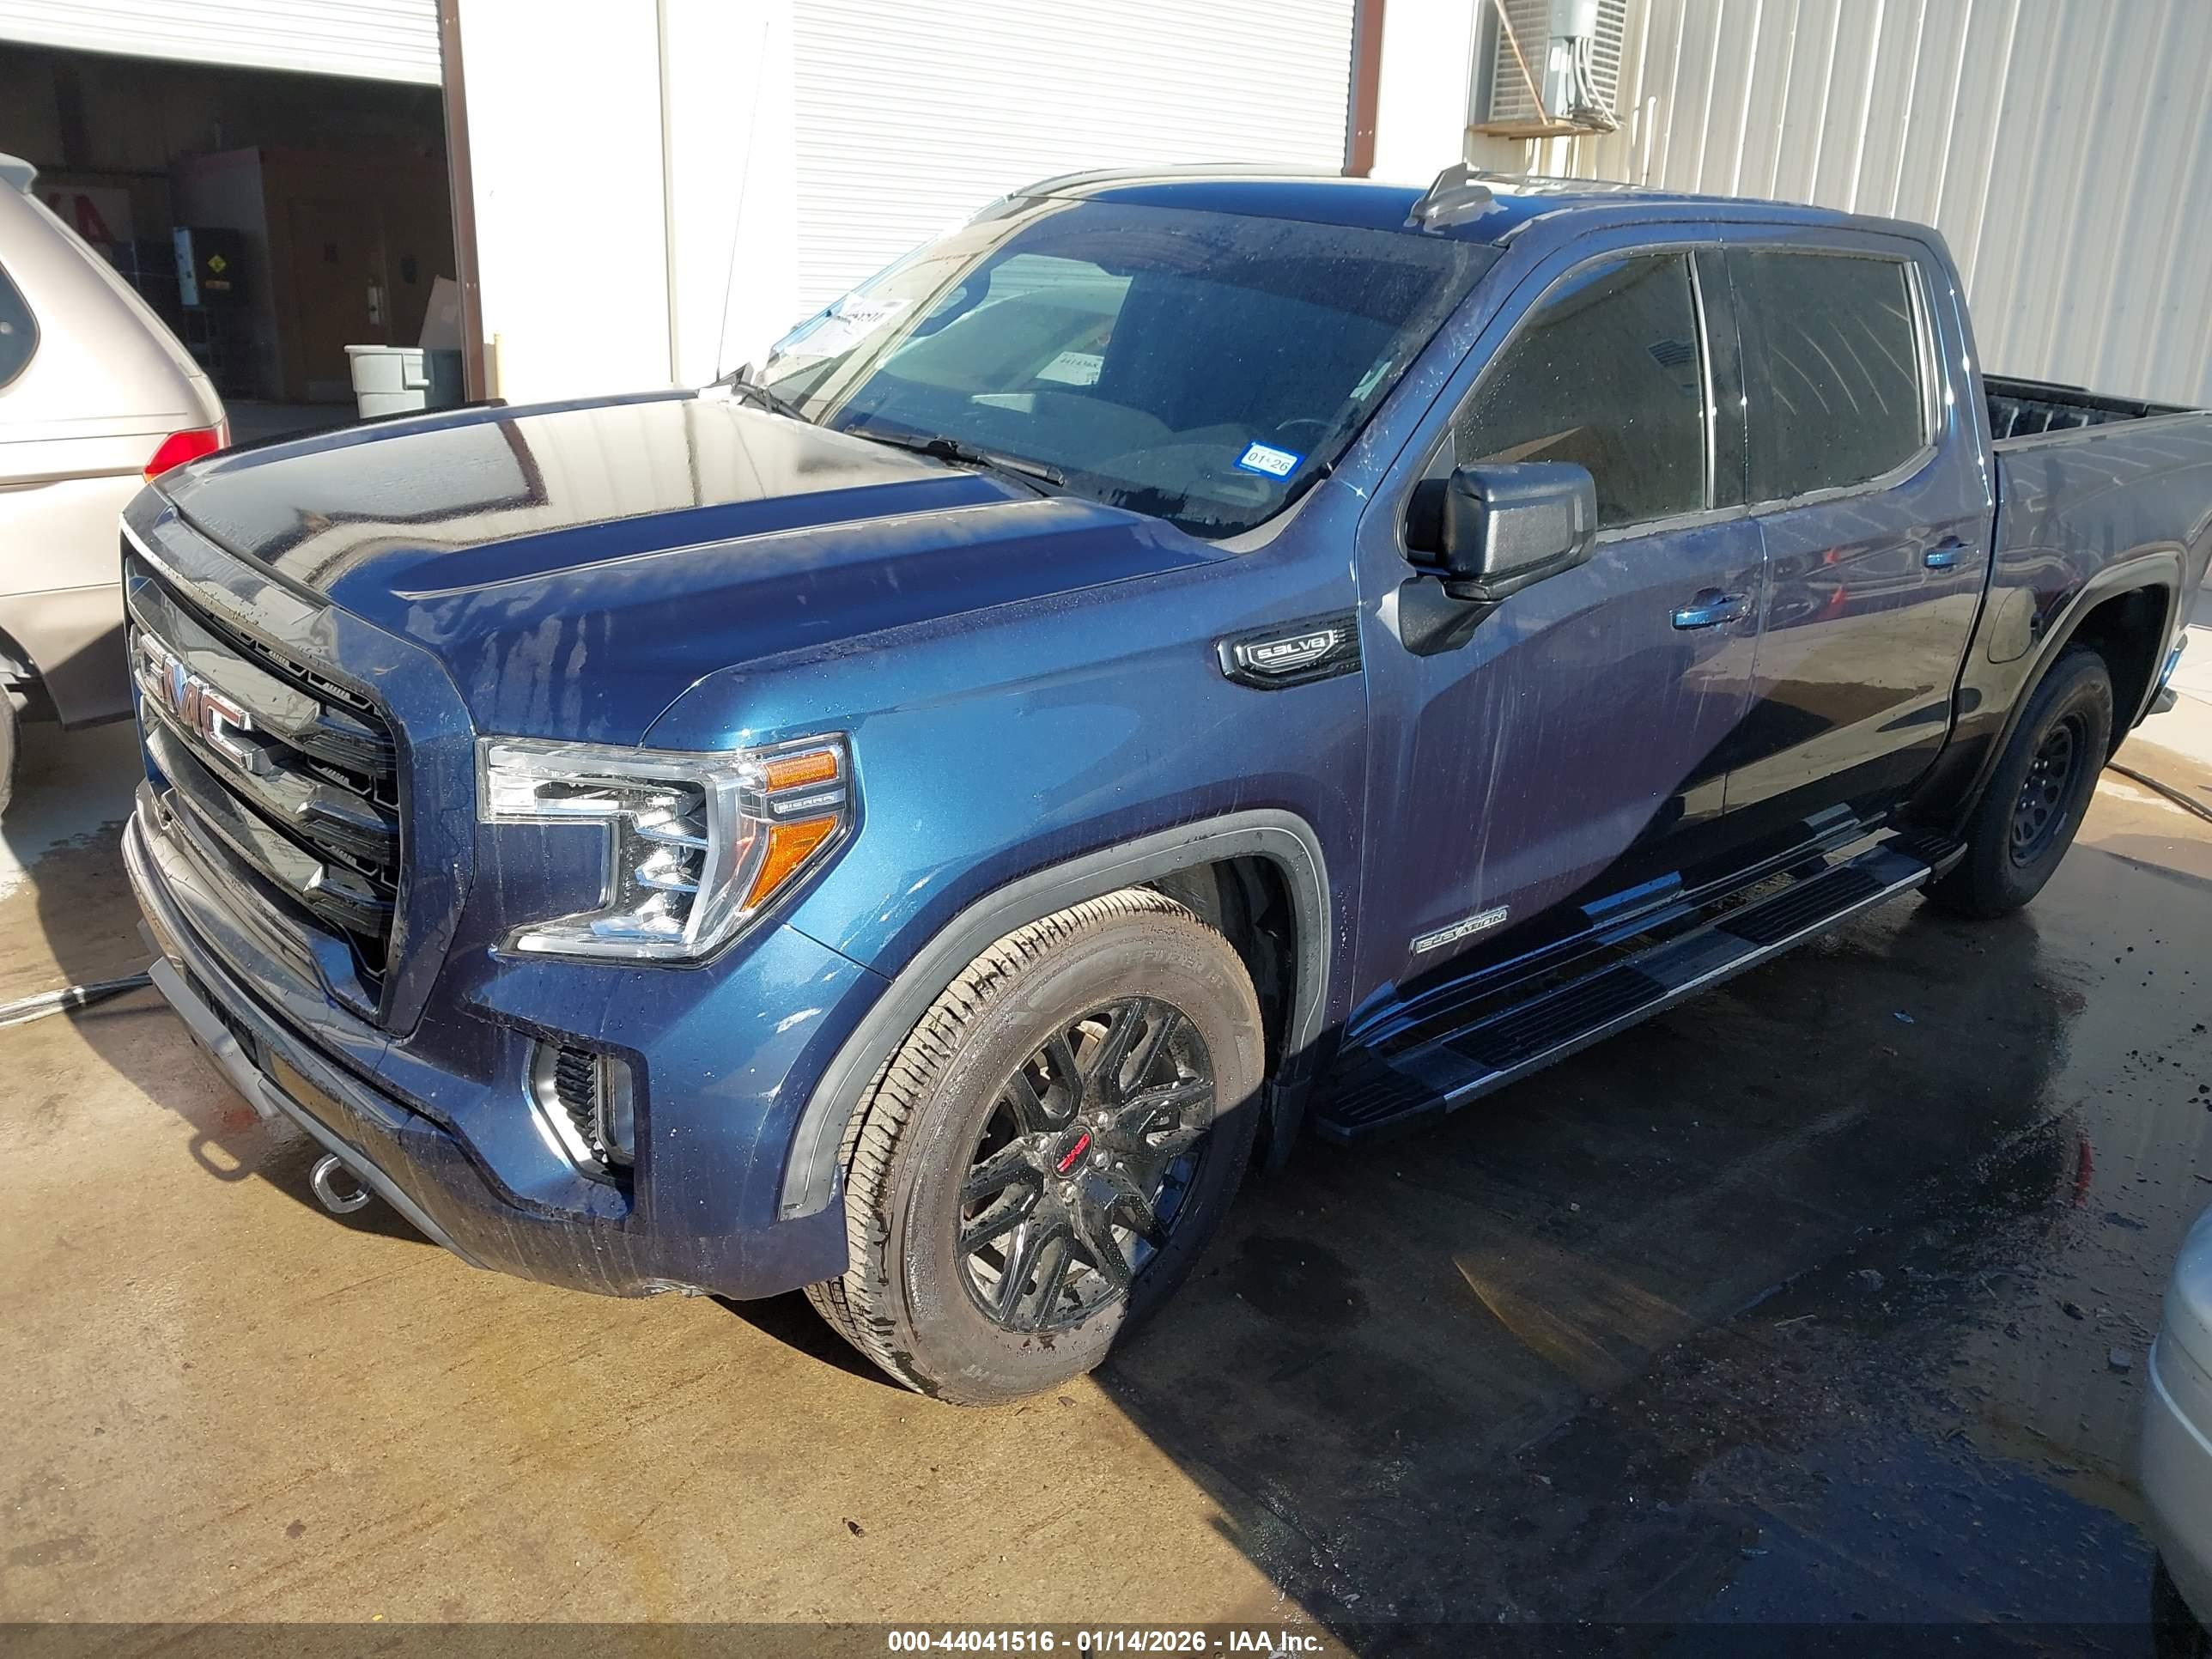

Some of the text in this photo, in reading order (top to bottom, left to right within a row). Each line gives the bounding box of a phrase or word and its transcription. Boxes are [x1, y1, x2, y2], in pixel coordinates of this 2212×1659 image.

[1270, 459, 1291, 471] 26
[135, 632, 254, 771] GMC
[1056, 1133, 1090, 1173] GMC
